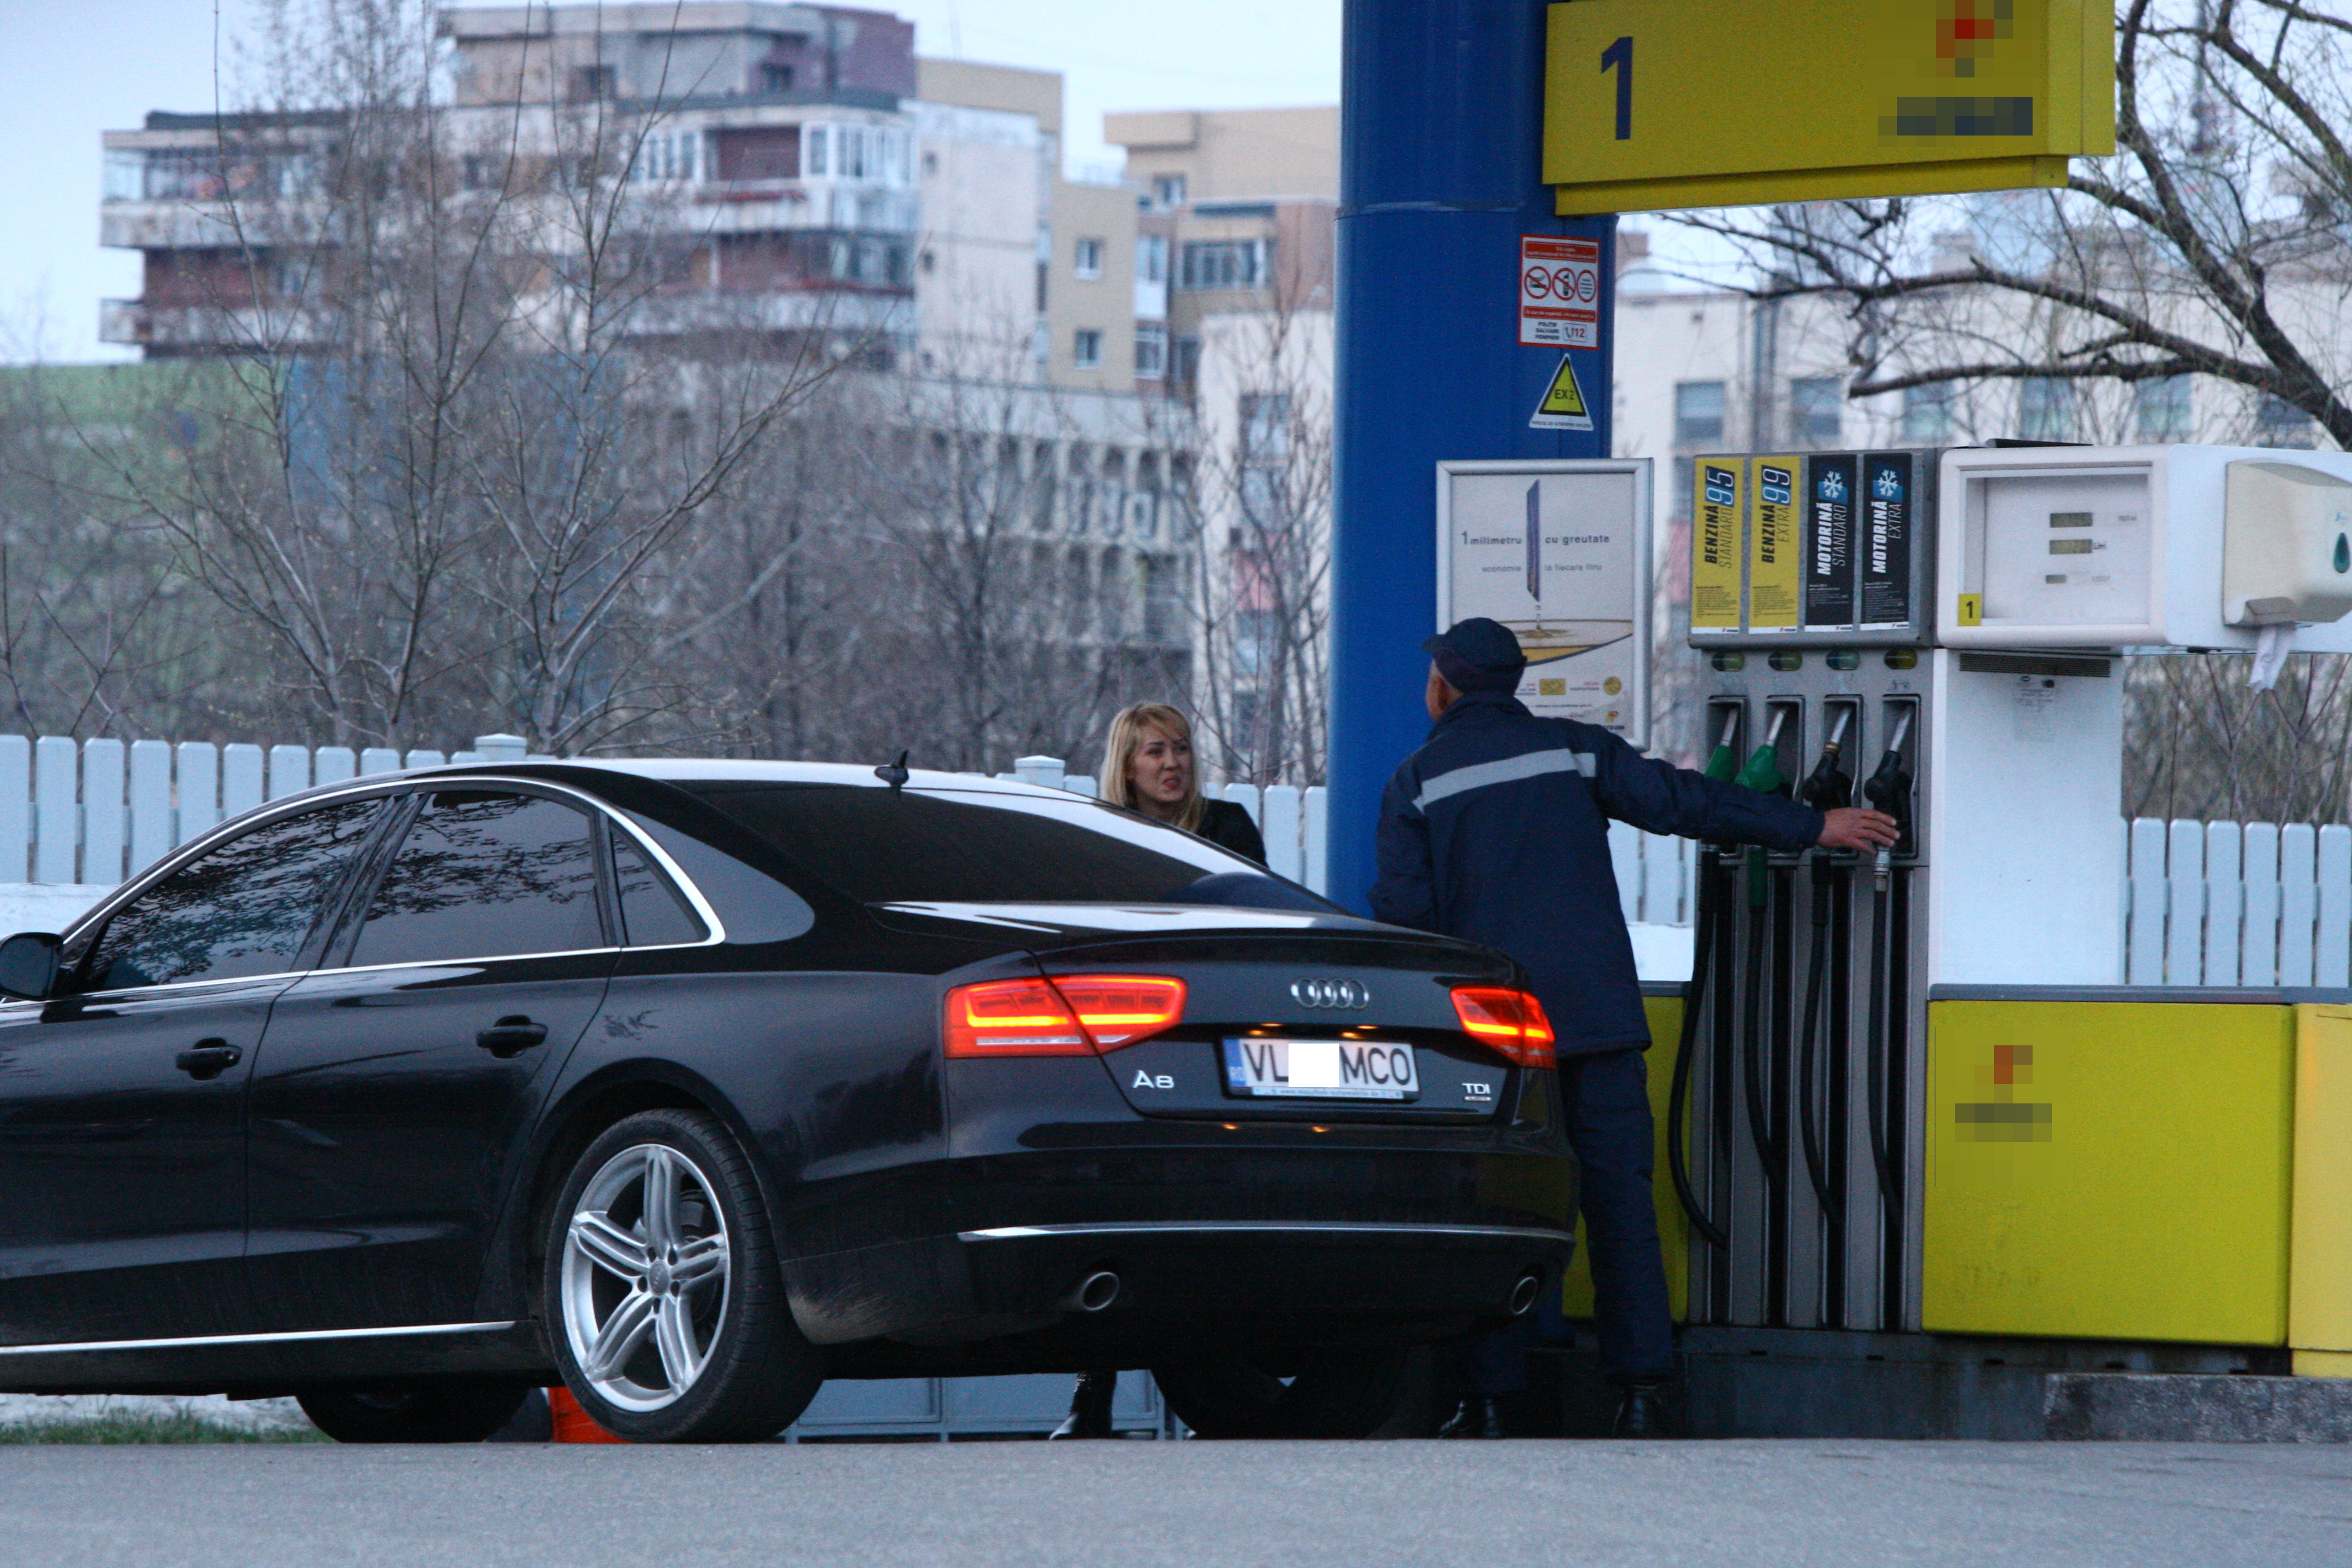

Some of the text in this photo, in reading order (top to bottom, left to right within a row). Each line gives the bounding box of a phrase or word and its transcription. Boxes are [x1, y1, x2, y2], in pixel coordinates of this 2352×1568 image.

[1601, 36, 1633, 140] 1
[1571, 327, 1585, 338] 112
[1706, 468, 1734, 505] 95
[1762, 468, 1790, 504] 99
[1462, 531, 1468, 544] 1
[1562, 535, 1610, 546] greutate
[1704, 505, 1719, 564] BENZINĂ
[1719, 508, 1733, 569] STANDARD
[1760, 505, 1775, 563] BENZINĂ
[1777, 507, 1790, 543] EXTRA
[1816, 503, 1833, 575] MOTORINĂ
[1832, 505, 1847, 567] STANDARD
[1871, 501, 1888, 573] MOTORINĂ
[1887, 503, 1902, 539] EXTRA
[1965, 600, 1974, 618] 1
[1133, 1070, 1174, 1089] A8
[1244, 1044, 1411, 1085] VL MCO
[1462, 1082, 1491, 1094] TDI
